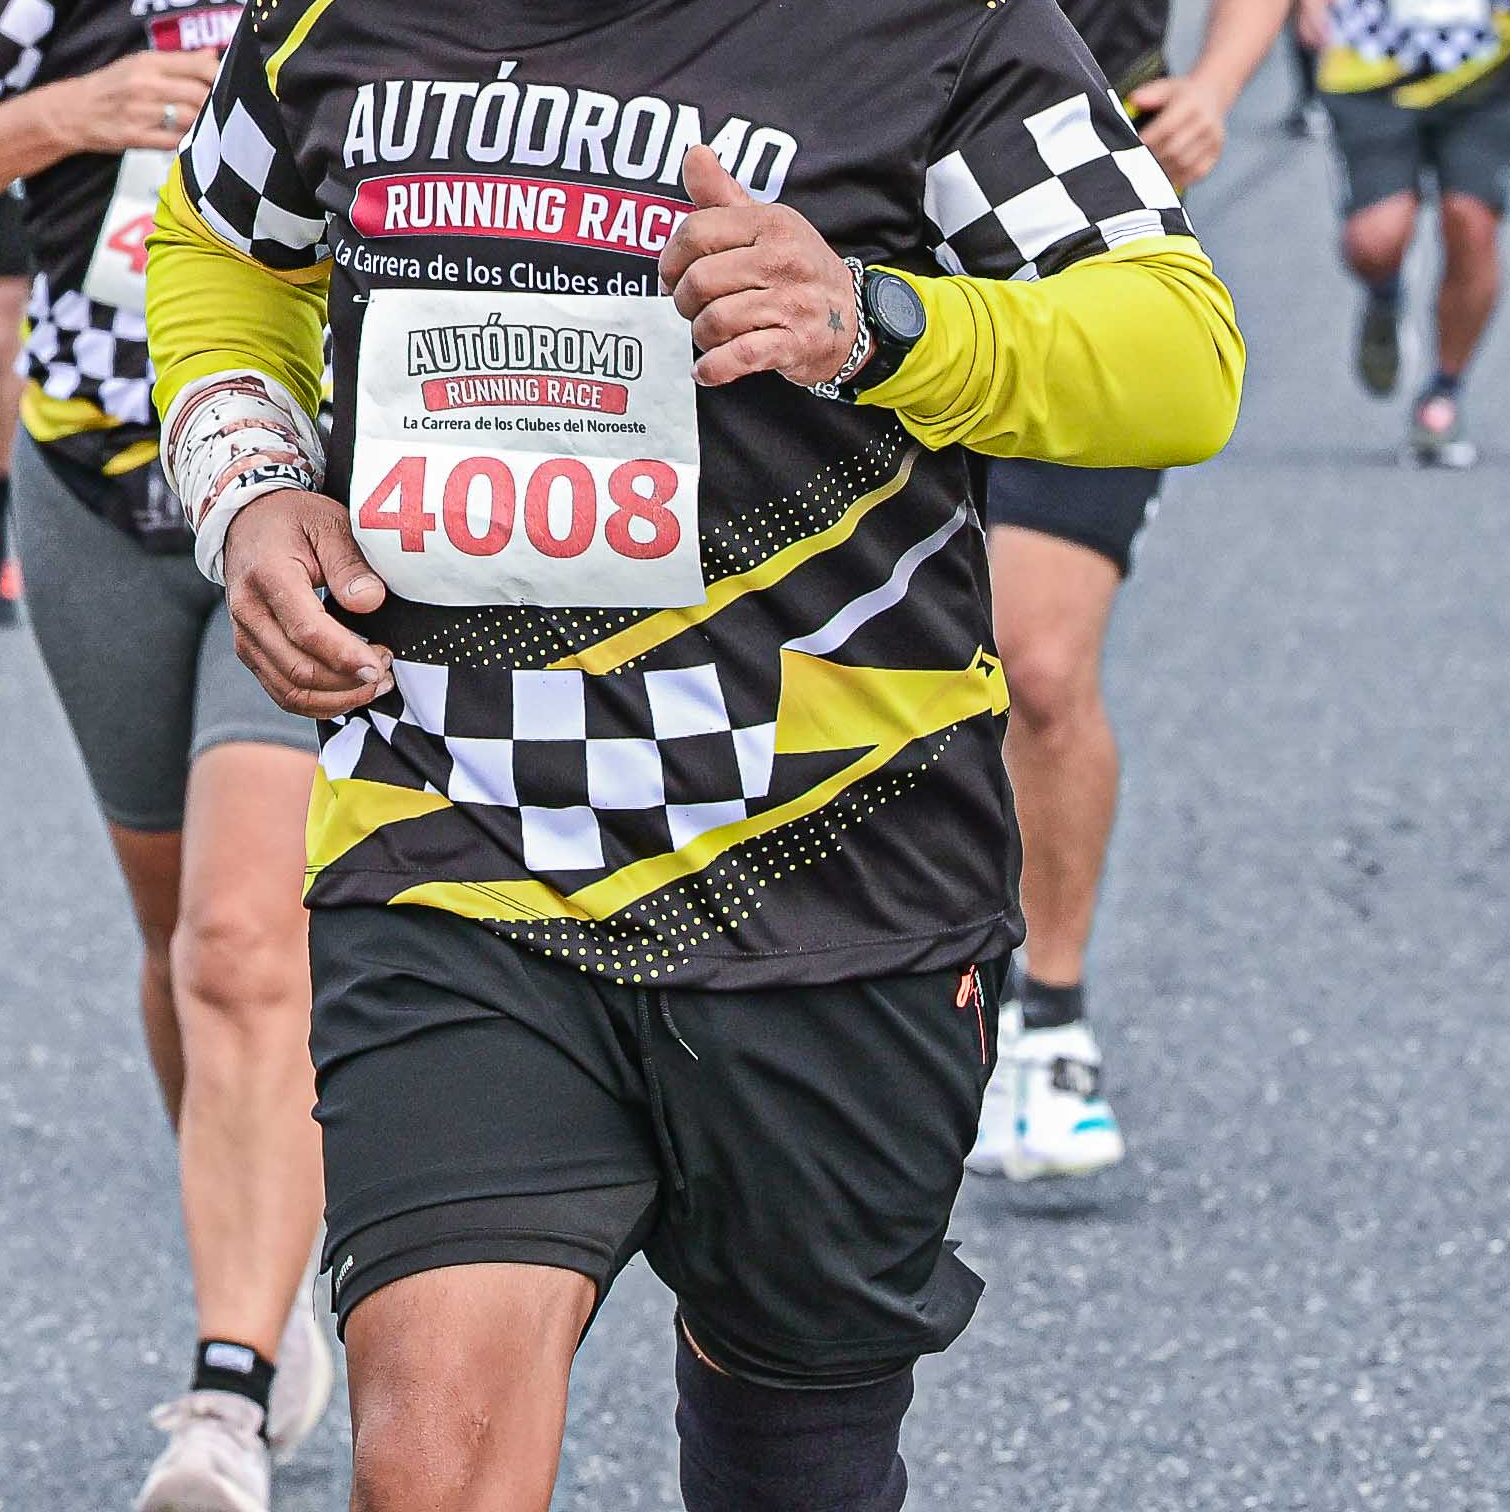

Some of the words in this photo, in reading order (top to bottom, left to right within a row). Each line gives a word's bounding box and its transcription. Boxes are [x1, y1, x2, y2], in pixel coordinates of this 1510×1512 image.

[342, 61, 798, 204] AUTÓDROMO
[384, 181, 568, 235] RUNNING
[335, 239, 351, 266] La
[353, 244, 421, 279] Carrera
[427, 254, 459, 282] de
[466, 257, 503, 285] los
[509, 262, 598, 295] Clubes
[606, 271, 648, 297] del
[408, 313, 642, 380] AUTÓDROMO
[445, 377, 540, 407] RUNNING
[547, 381, 603, 409] RACE
[403, 416, 418, 430] La
[421, 416, 471, 430] Carrera
[475, 416, 492, 431] de
[495, 417, 513, 431] los
[516, 417, 561, 433] Clubes
[564, 419, 584, 433] del
[587, 420, 647, 434] Noroeste
[358, 456, 681, 560] 4008
